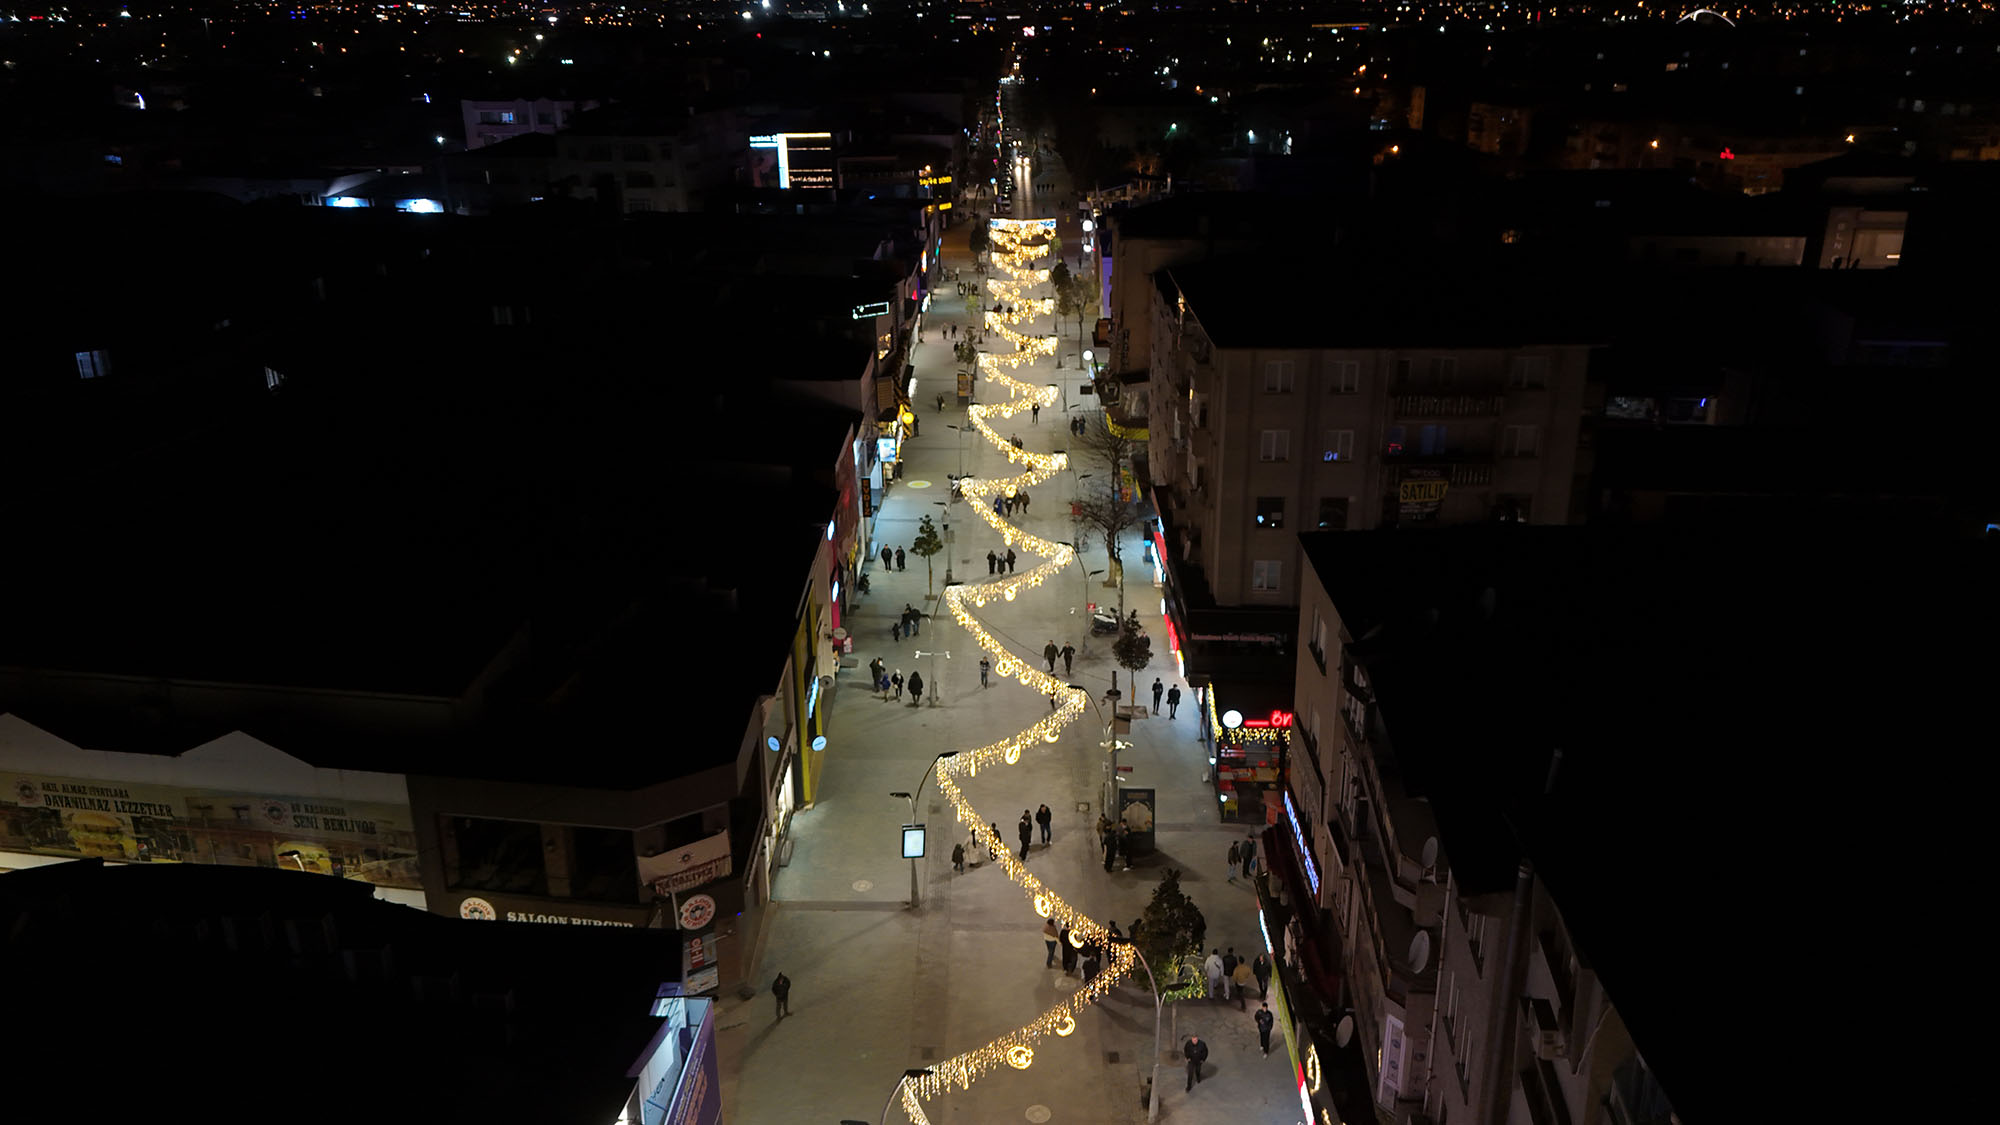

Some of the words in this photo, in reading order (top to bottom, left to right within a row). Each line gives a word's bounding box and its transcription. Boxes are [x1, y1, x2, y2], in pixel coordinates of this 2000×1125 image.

[61, 783, 87, 795] ALMAZ
[43, 794, 111, 812] DAYANILMAZ
[114, 800, 173, 817] LEZZETLER
[507, 911, 568, 925] SALOON
